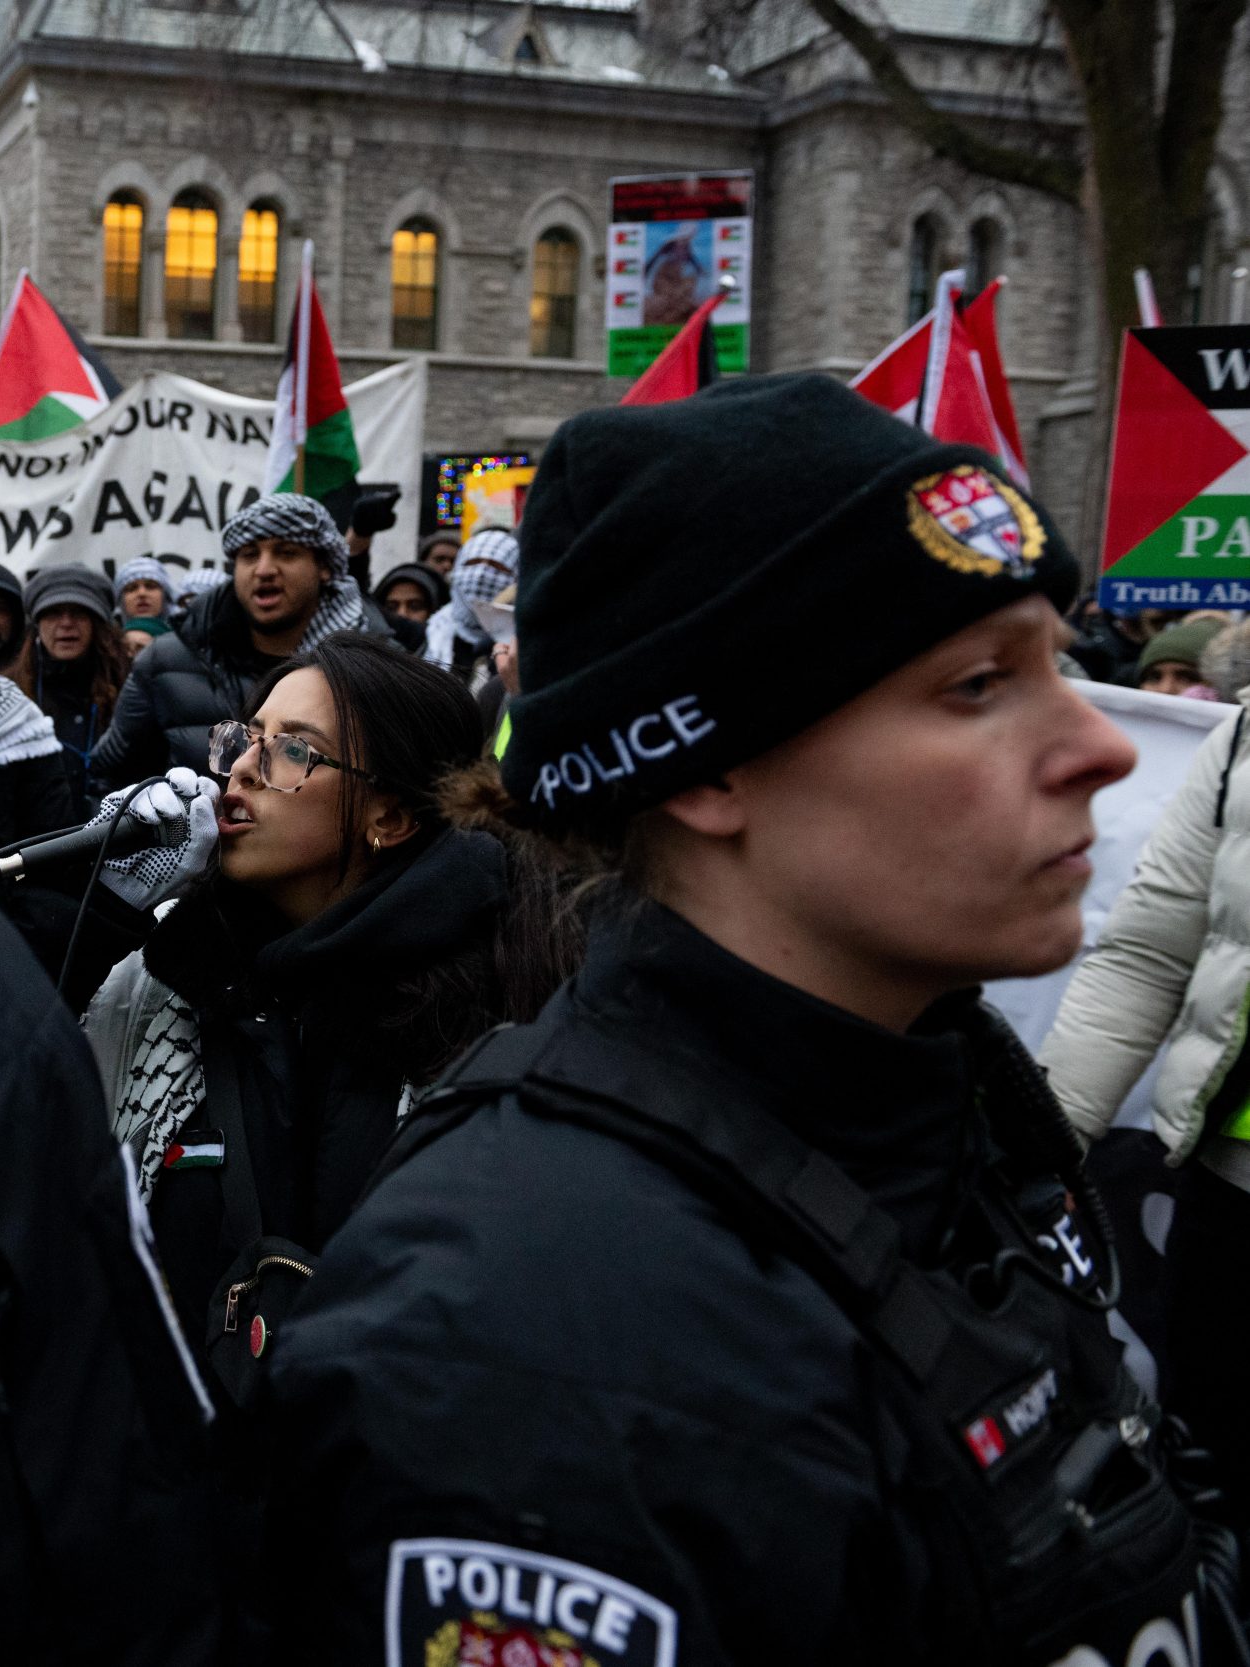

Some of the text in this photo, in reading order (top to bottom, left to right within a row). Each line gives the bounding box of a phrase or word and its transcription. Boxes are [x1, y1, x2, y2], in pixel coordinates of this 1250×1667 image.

[113, 397, 194, 437] OUR
[206, 409, 274, 448] NA
[1174, 515, 1250, 559] PA
[1110, 581, 1250, 604] Truth Ab
[529, 694, 717, 809] POLICE
[423, 1553, 637, 1654] POLICE
